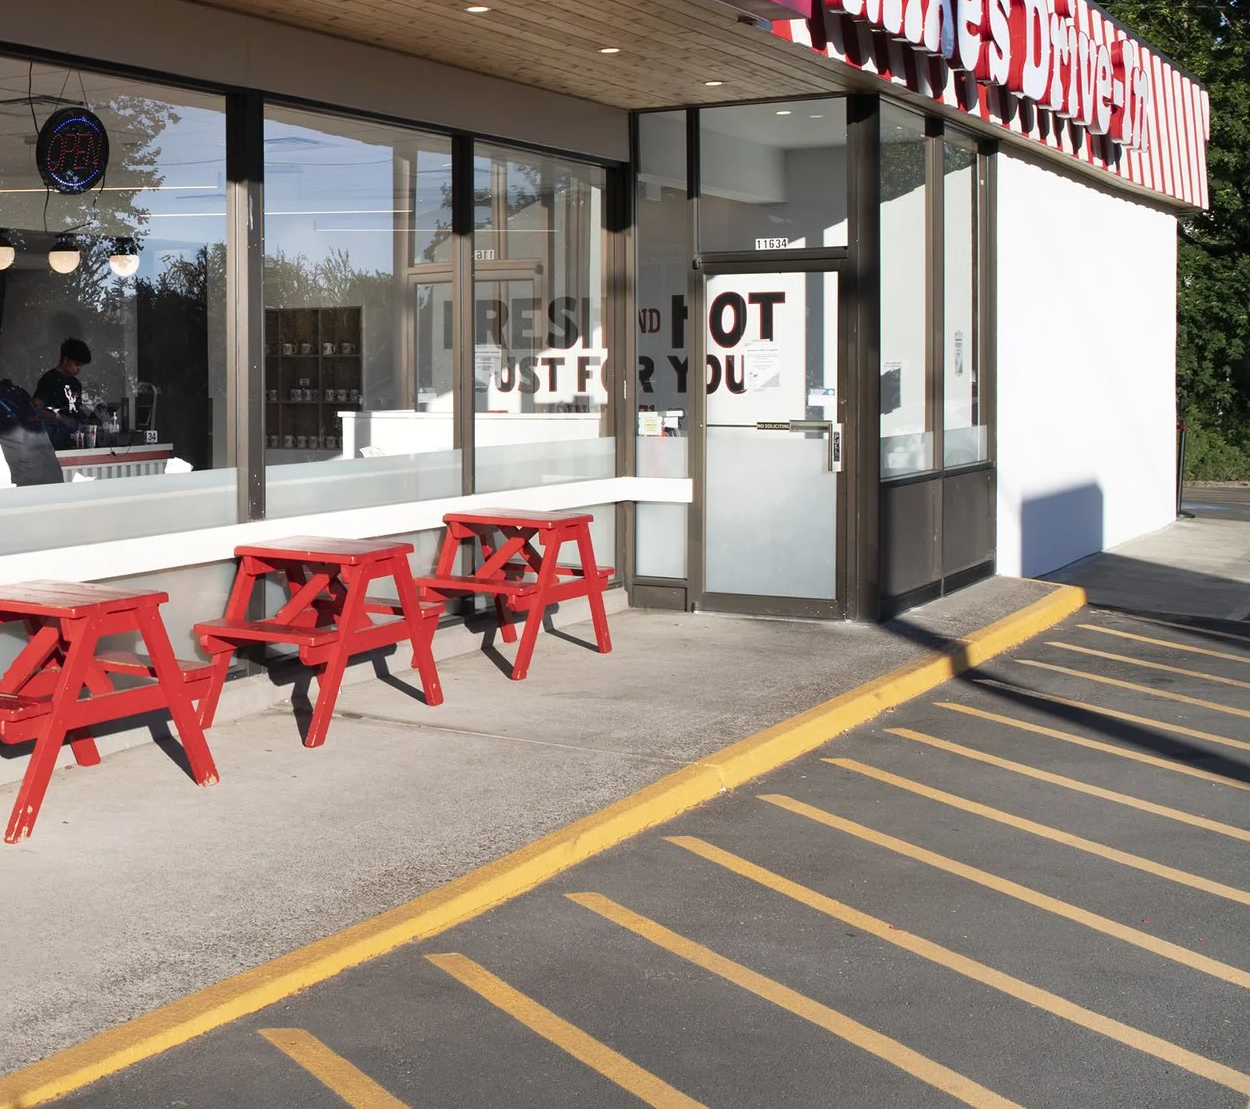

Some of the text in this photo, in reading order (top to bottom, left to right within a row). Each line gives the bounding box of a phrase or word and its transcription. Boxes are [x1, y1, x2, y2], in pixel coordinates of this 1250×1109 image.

[47, 133, 103, 171] OPEN
[757, 238, 788, 249] 11634
[639, 308, 661, 334] ND
[479, 356, 565, 394] UST
[577, 356, 655, 394] FR
[147, 432, 157, 441] 34
